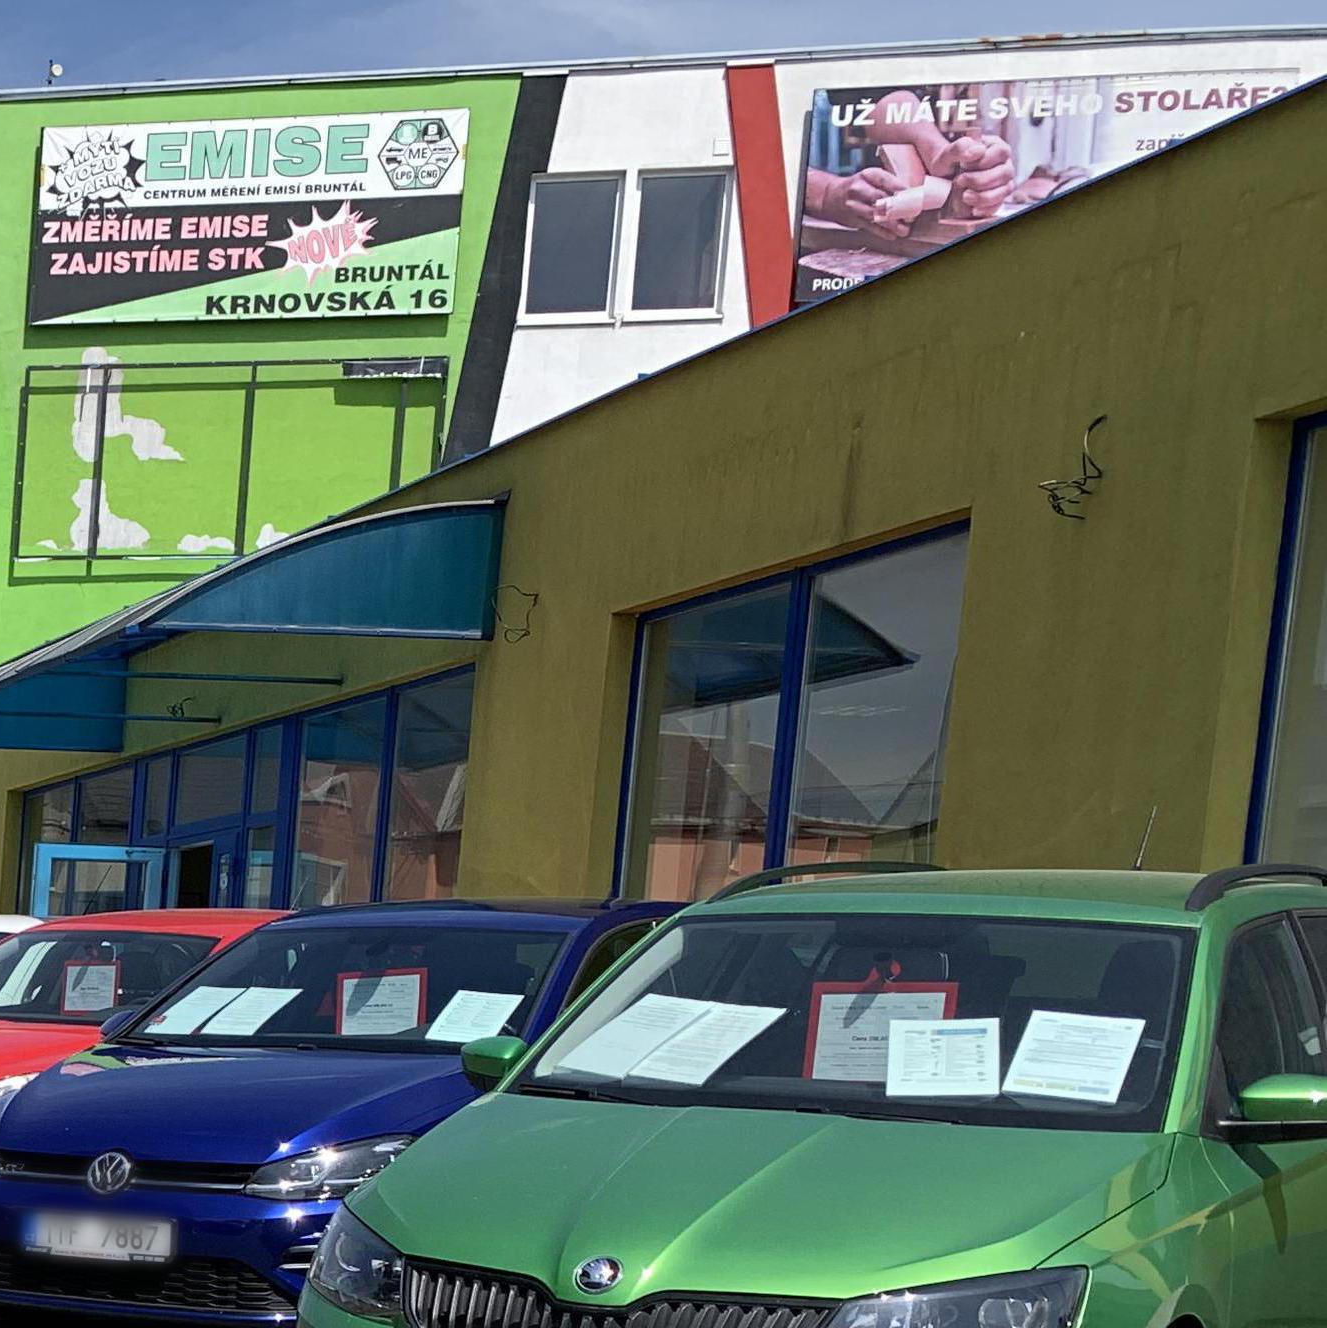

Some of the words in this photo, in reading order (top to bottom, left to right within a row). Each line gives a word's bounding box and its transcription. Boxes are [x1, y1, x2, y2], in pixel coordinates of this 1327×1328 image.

[831, 98, 876, 127] UŽ
[886, 98, 978, 125] MÁTE
[145, 124, 370, 182] EMISE
[408, 148, 429, 159] ME
[64, 158, 118, 188] VOZU
[395, 169, 412, 180] LPG
[420, 168, 439, 179] CNG
[56, 173, 137, 209] ZDARMA
[144, 188, 206, 199] CENTRUM
[210, 183, 261, 198] MĚŘENÍ
[264, 182, 301, 196] EMISÍ
[305, 180, 366, 194] BRUNTÁL
[41, 213, 172, 244] ZMĚŘÍME
[180, 214, 269, 240] EMISE
[49, 244, 199, 276] ZAJISTÍME
[208, 247, 266, 271] STK
[334, 259, 450, 284] BRUNTÁL
[205, 284, 396, 316] KRNOVSKÁ
[410, 288, 449, 309] 16
